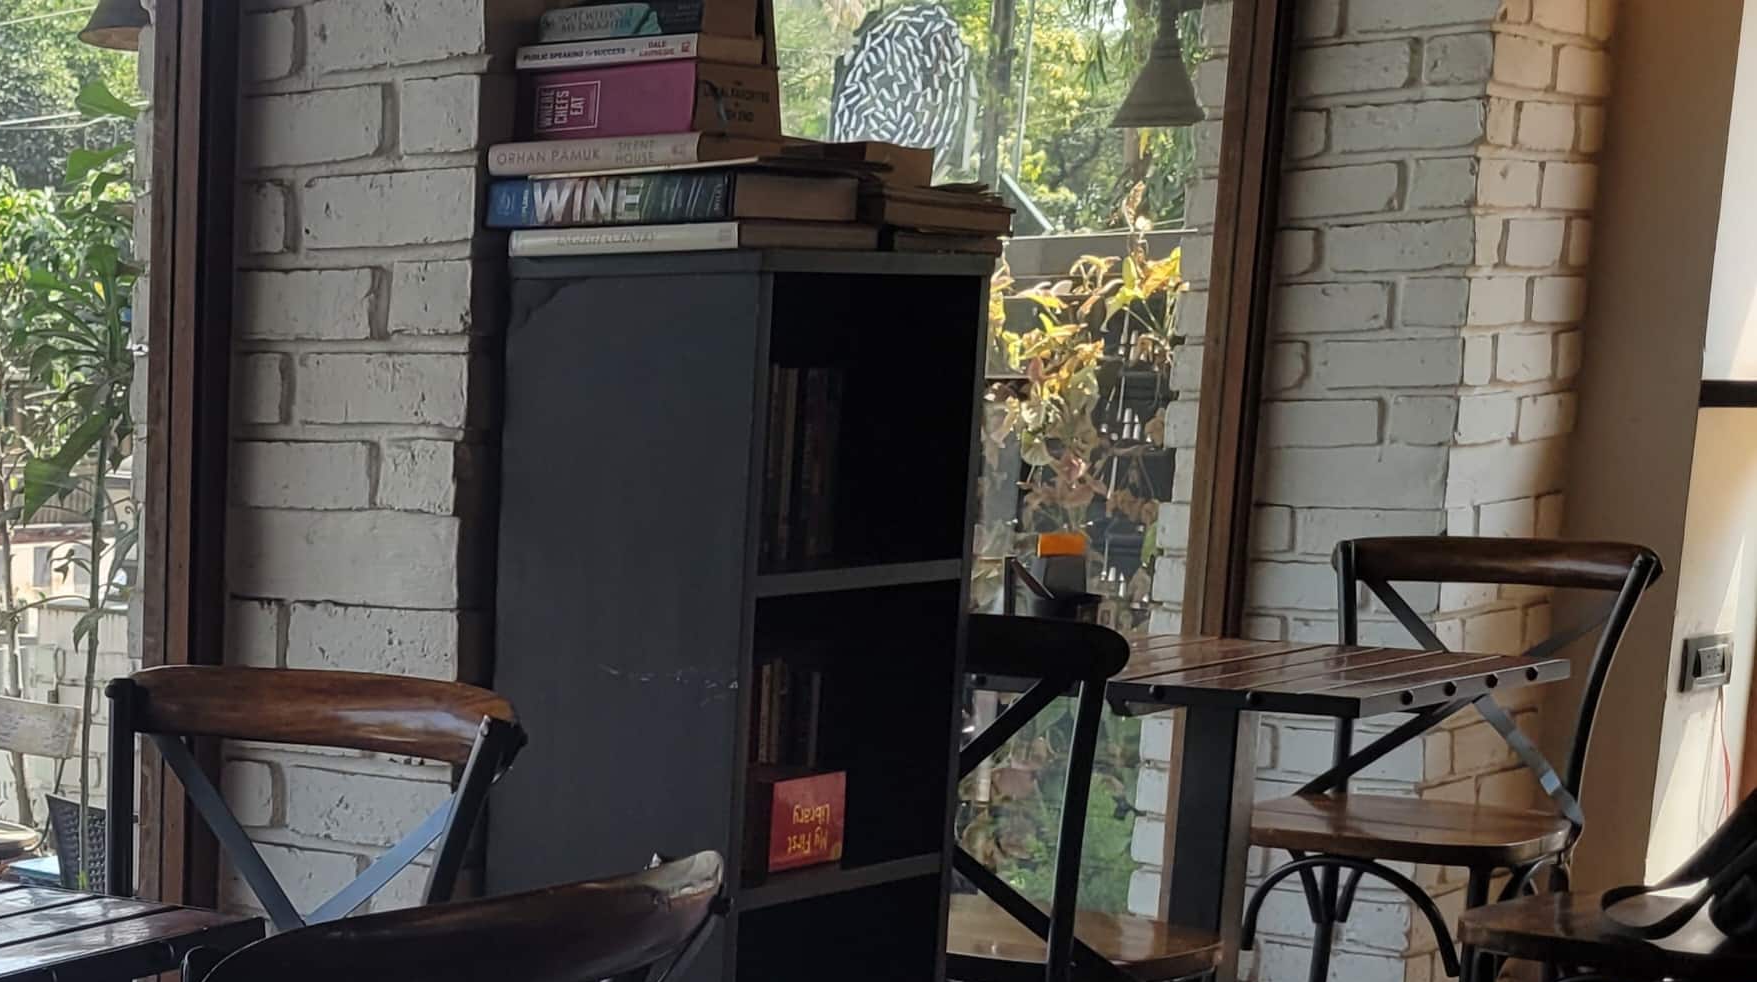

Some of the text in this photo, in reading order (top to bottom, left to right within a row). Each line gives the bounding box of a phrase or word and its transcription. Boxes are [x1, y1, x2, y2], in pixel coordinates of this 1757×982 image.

[523, 53, 548, 62] PUBLIC
[549, 50, 584, 60] SPEAKING
[593, 47, 626, 57] SUCCESS
[648, 41, 667, 49] DALE
[539, 89, 554, 127] WHERE
[554, 90, 569, 124] CHEFS
[570, 96, 585, 115] EAT
[496, 148, 601, 166] ORHAN PAMUK
[616, 152, 655, 164] HOUSE
[533, 177, 645, 223] WINE
[793, 803, 830, 825] Library
[787, 826, 828, 855] My First
